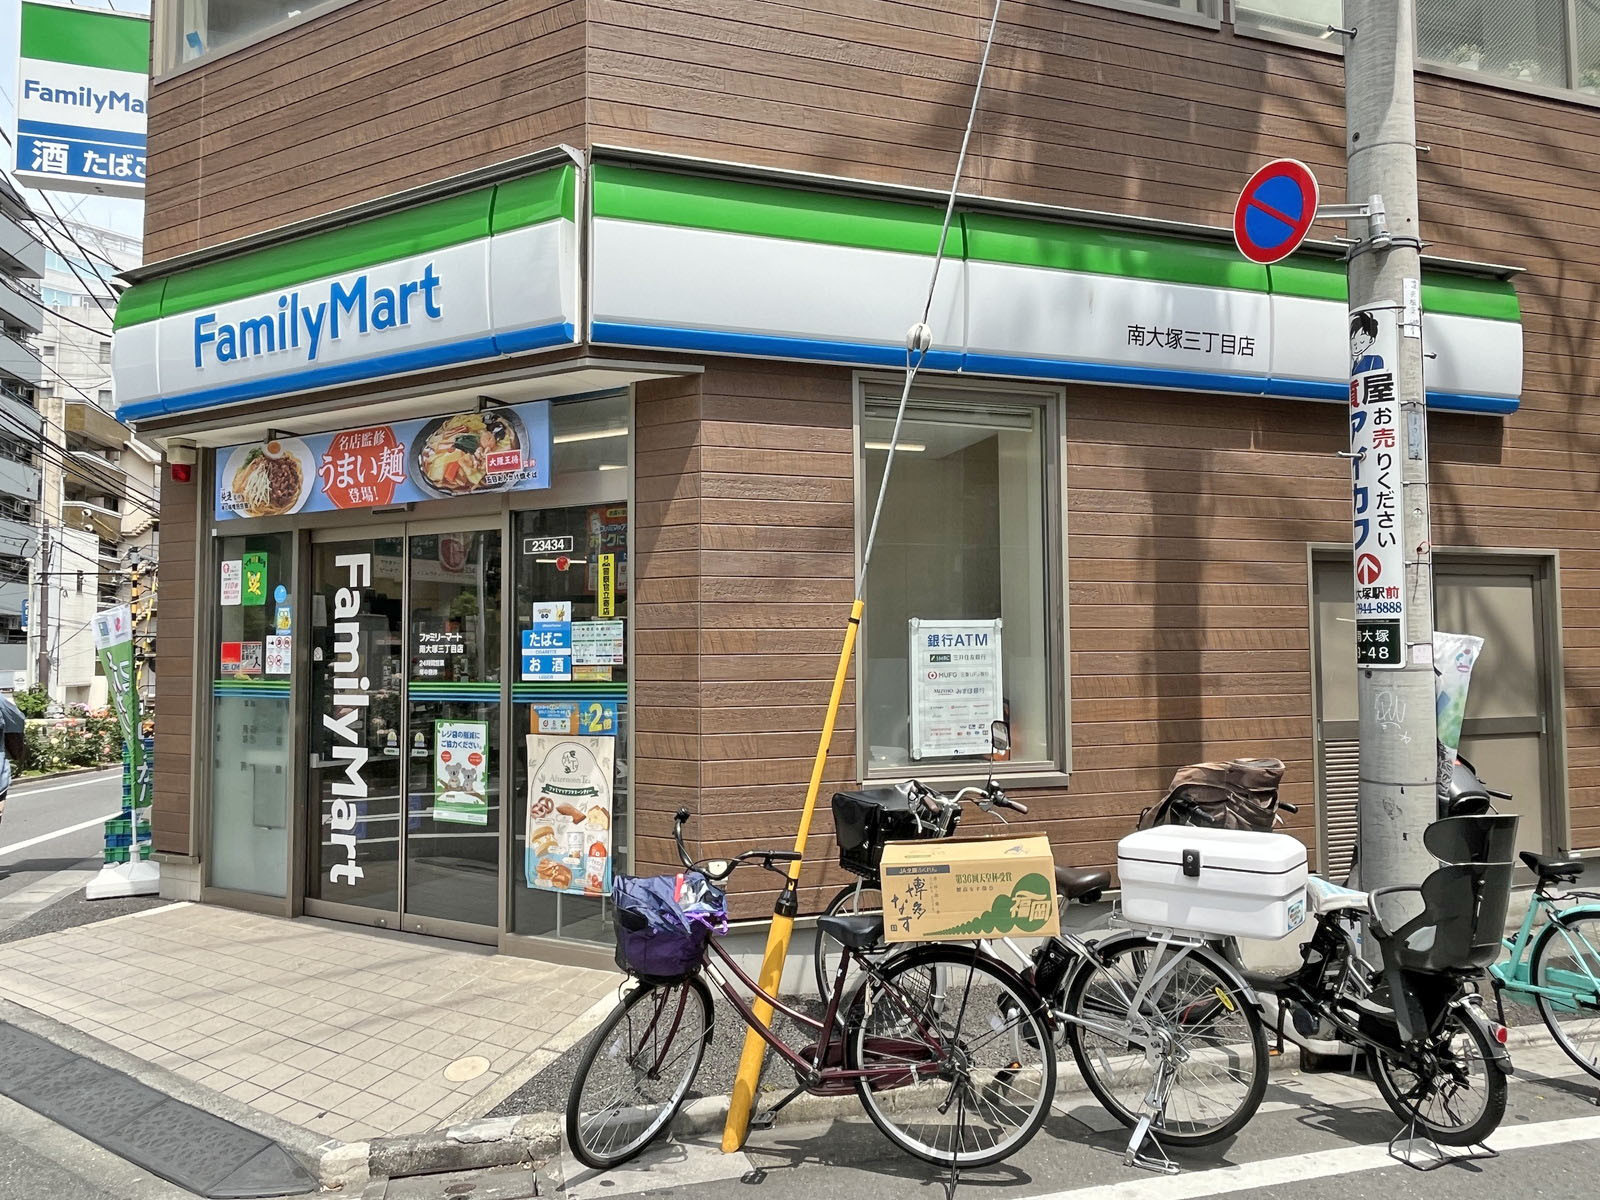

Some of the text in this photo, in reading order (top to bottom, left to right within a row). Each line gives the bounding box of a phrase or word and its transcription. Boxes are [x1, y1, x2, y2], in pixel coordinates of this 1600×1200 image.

[31, 139, 69, 174] 酒
[194, 262, 441, 368] FamilyMart
[1127, 324, 1255, 357] 南大塚三丁目店
[340, 430, 386, 451] 名店監修
[318, 443, 407, 493] うまい麺
[489, 455, 519, 467] 大阪王将
[1372, 407, 1396, 548] お売りください
[348, 486, 379, 503] 登場!
[532, 539, 565, 551] 23434
[419, 632, 463, 642] ファミリーマート
[529, 632, 563, 647] たばこ
[927, 633, 988, 648] 銀行ATM
[419, 644, 464, 654] 南大塚三丁目店
[323, 553, 370, 886] FamilyMart
